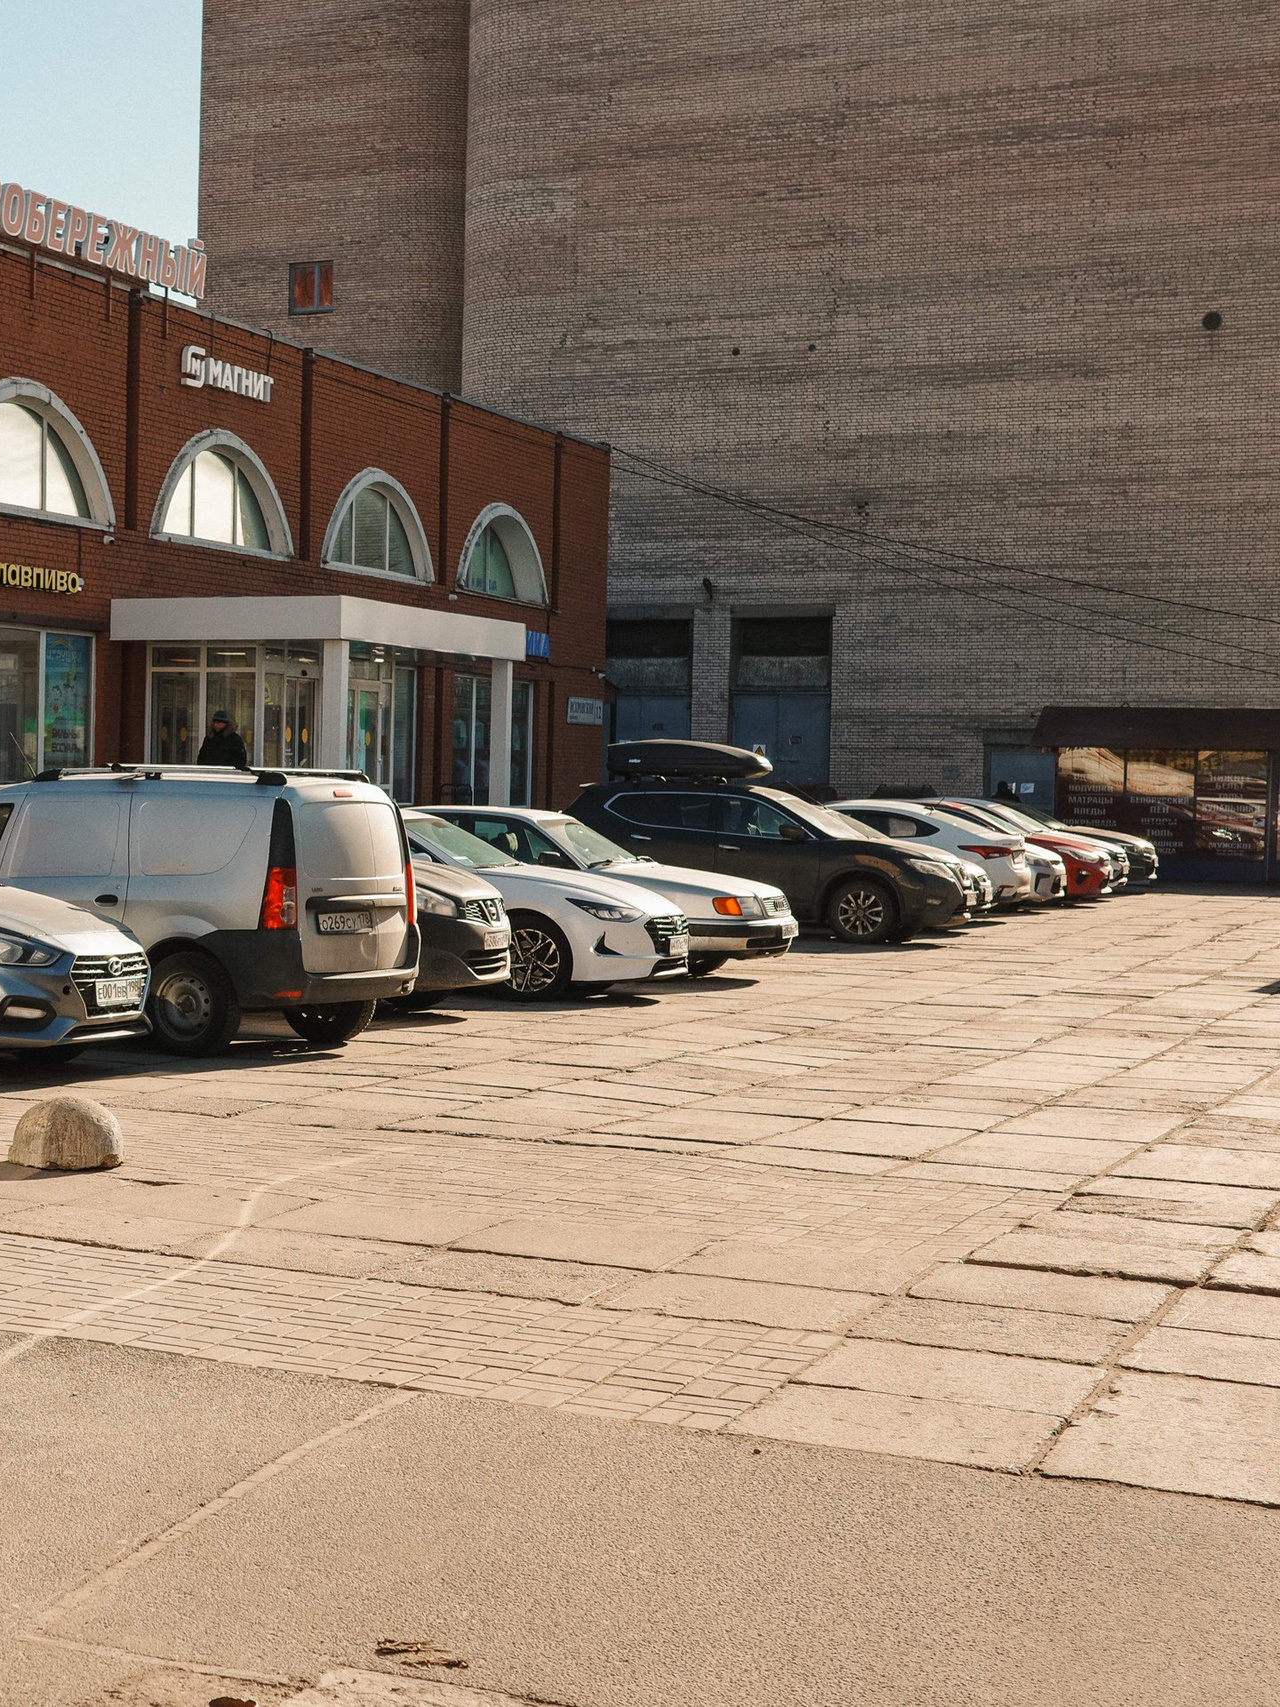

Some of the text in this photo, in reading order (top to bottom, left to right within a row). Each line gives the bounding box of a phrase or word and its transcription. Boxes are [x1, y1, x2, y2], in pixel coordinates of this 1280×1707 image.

[205, 358, 274, 402] МАГНИТ
[1068, 784, 1113, 793] ПОДУШКИ
[1068, 796, 1113, 805] МАТРАЦЫ
[1073, 807, 1106, 816] ПЛЕДЫ
[1146, 829, 1173, 837] ТЮЛЬ
